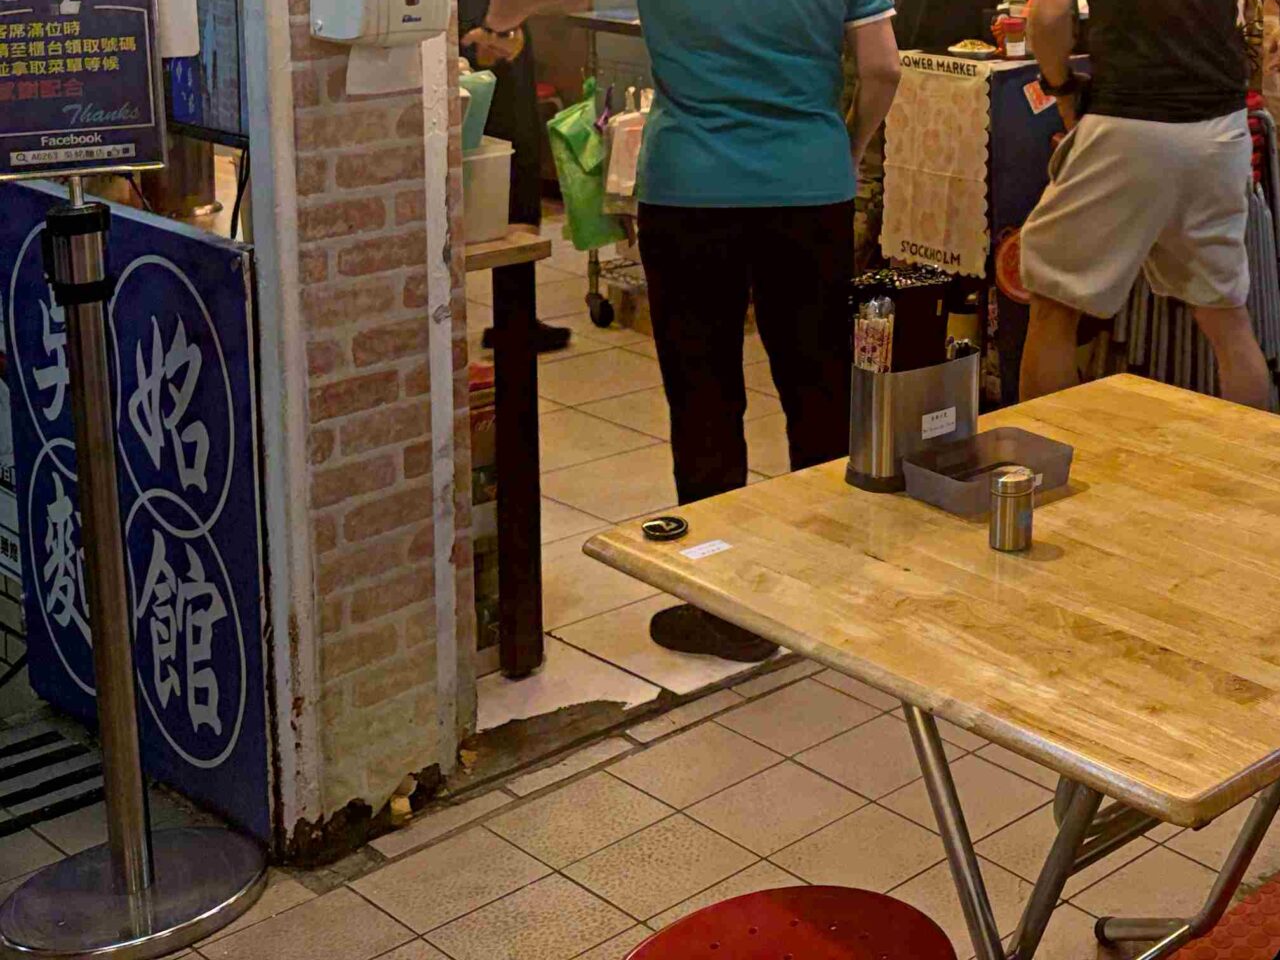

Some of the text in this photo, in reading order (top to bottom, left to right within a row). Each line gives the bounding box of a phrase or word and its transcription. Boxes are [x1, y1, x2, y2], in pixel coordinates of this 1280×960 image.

[936, 60, 978, 77] MARKET
[62, 102, 139, 126] Thanks
[40, 132, 102, 147] Facebook
[901, 240, 960, 266] STOCKHOLM
